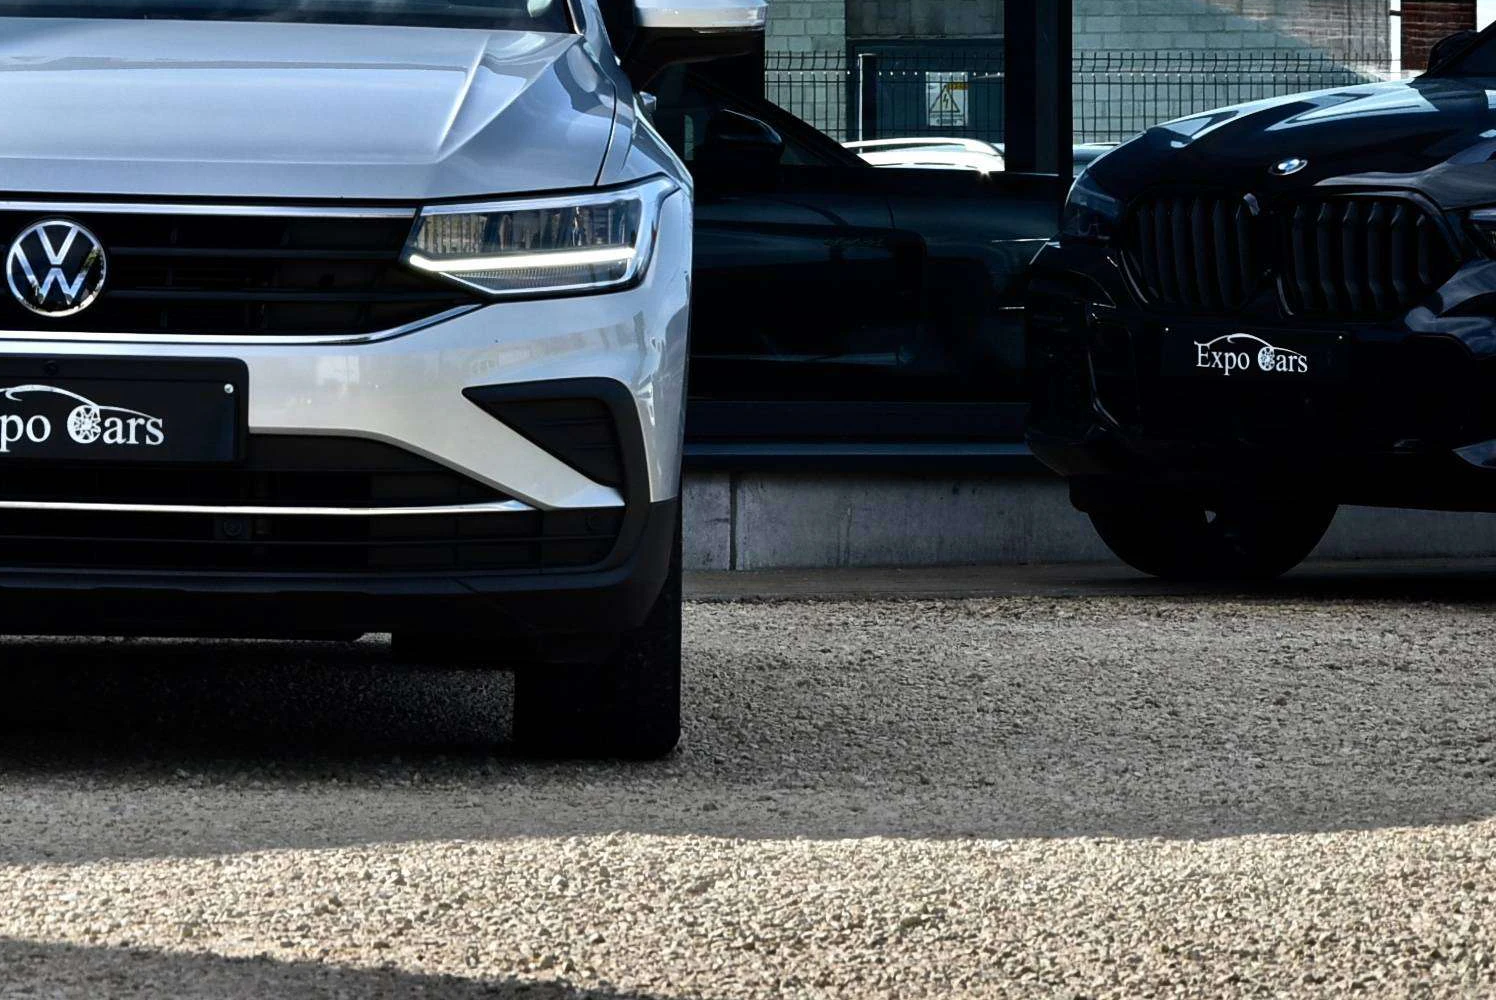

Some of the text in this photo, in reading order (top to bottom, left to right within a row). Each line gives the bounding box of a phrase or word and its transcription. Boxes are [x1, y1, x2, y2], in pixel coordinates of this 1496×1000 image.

[1194, 341, 1309, 377] Expo Cars
[66, 404, 165, 446] Cars
